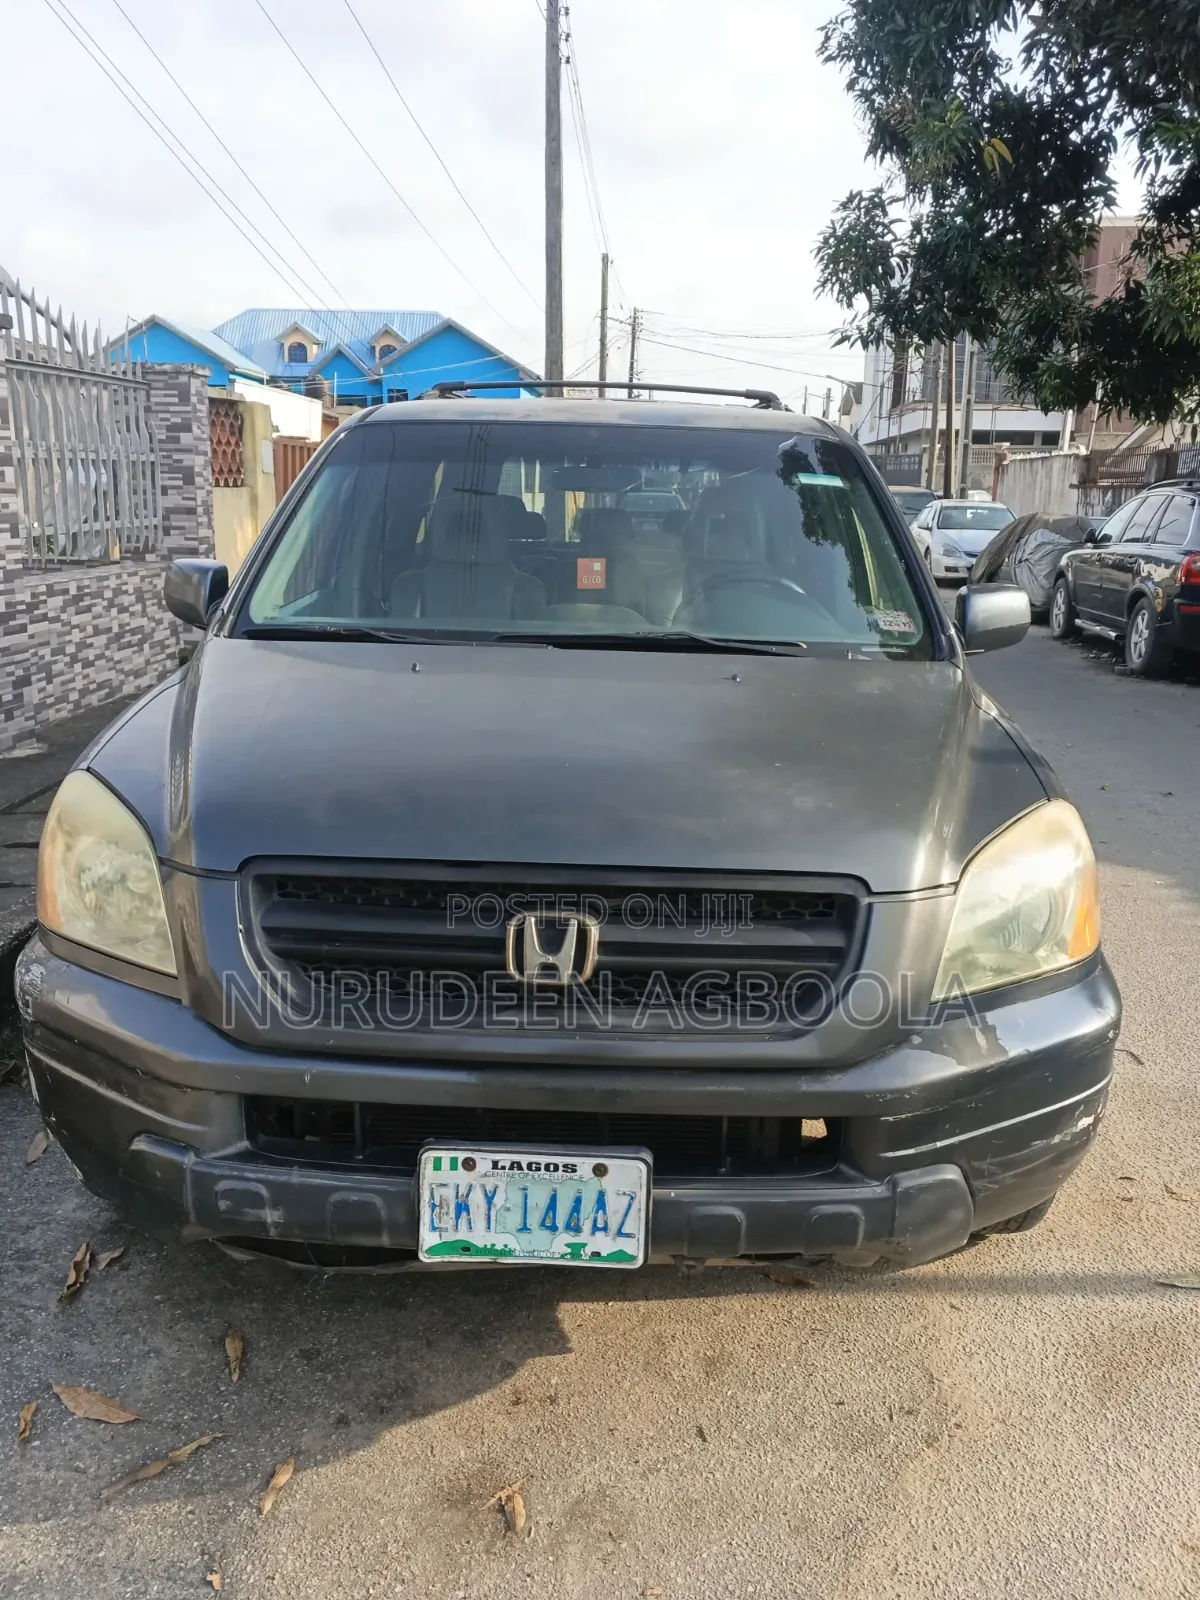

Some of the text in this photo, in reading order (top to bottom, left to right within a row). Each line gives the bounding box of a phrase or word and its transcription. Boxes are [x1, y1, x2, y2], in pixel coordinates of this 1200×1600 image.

[491, 1160, 578, 1174] LAGOS
[485, 1171, 585, 1182] CENTRE OF EXCELLENCE
